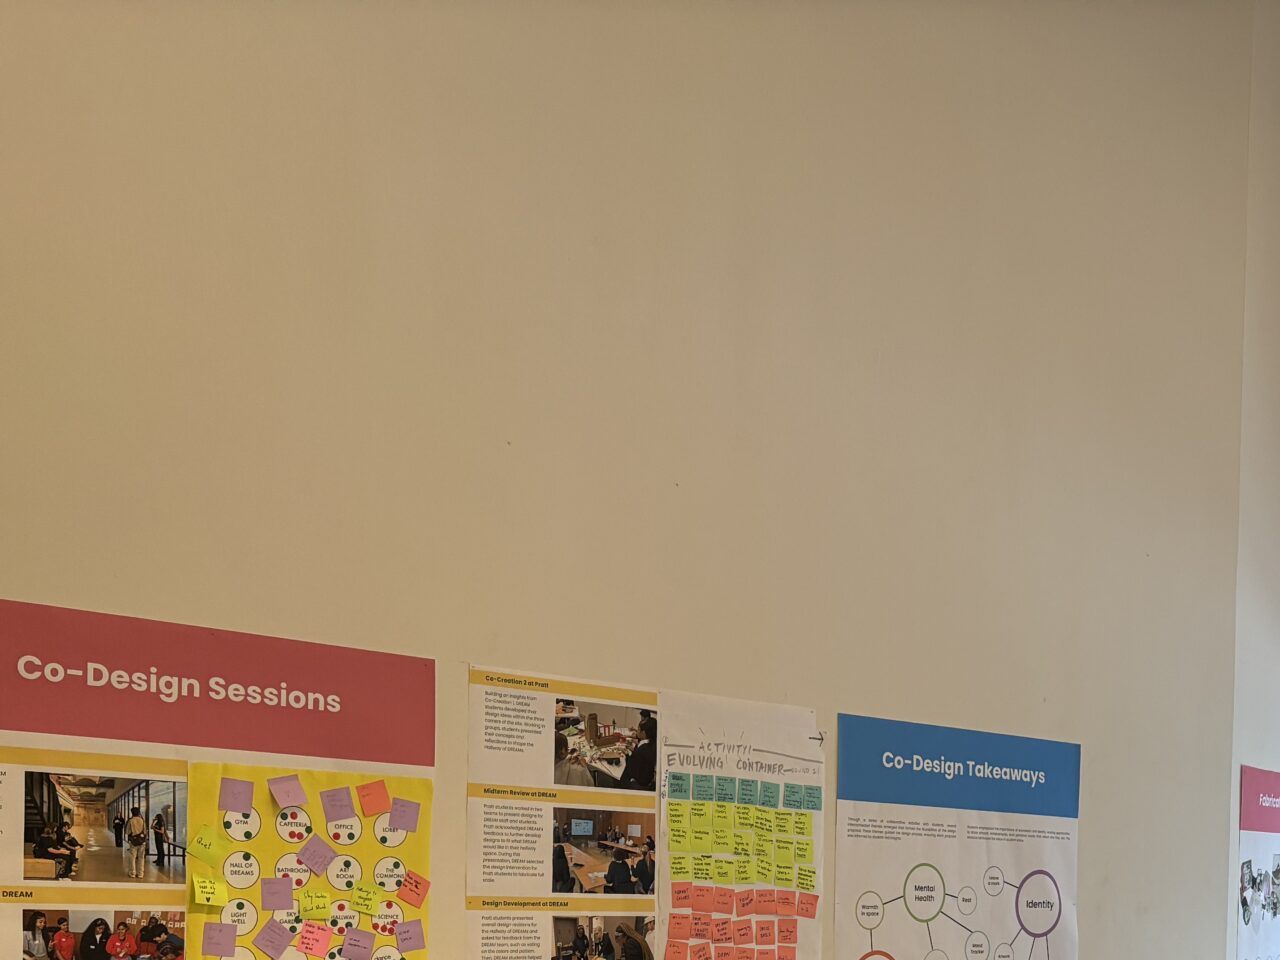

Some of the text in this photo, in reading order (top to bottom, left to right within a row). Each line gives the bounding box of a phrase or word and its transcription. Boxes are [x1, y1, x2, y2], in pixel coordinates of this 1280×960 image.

[17, 654, 341, 713] Co-Design Sessions
[486, 676, 522, 685] Co-Creation
[667, 752, 724, 770] EVOLVING
[736, 759, 785, 775] CONTAINER
[882, 751, 1046, 788] Co-Design Takeaways
[2, 889, 33, 899] DREAM
[914, 884, 936, 893] Mental
[914, 893, 935, 903] Health
[1026, 899, 1055, 912] Identity
